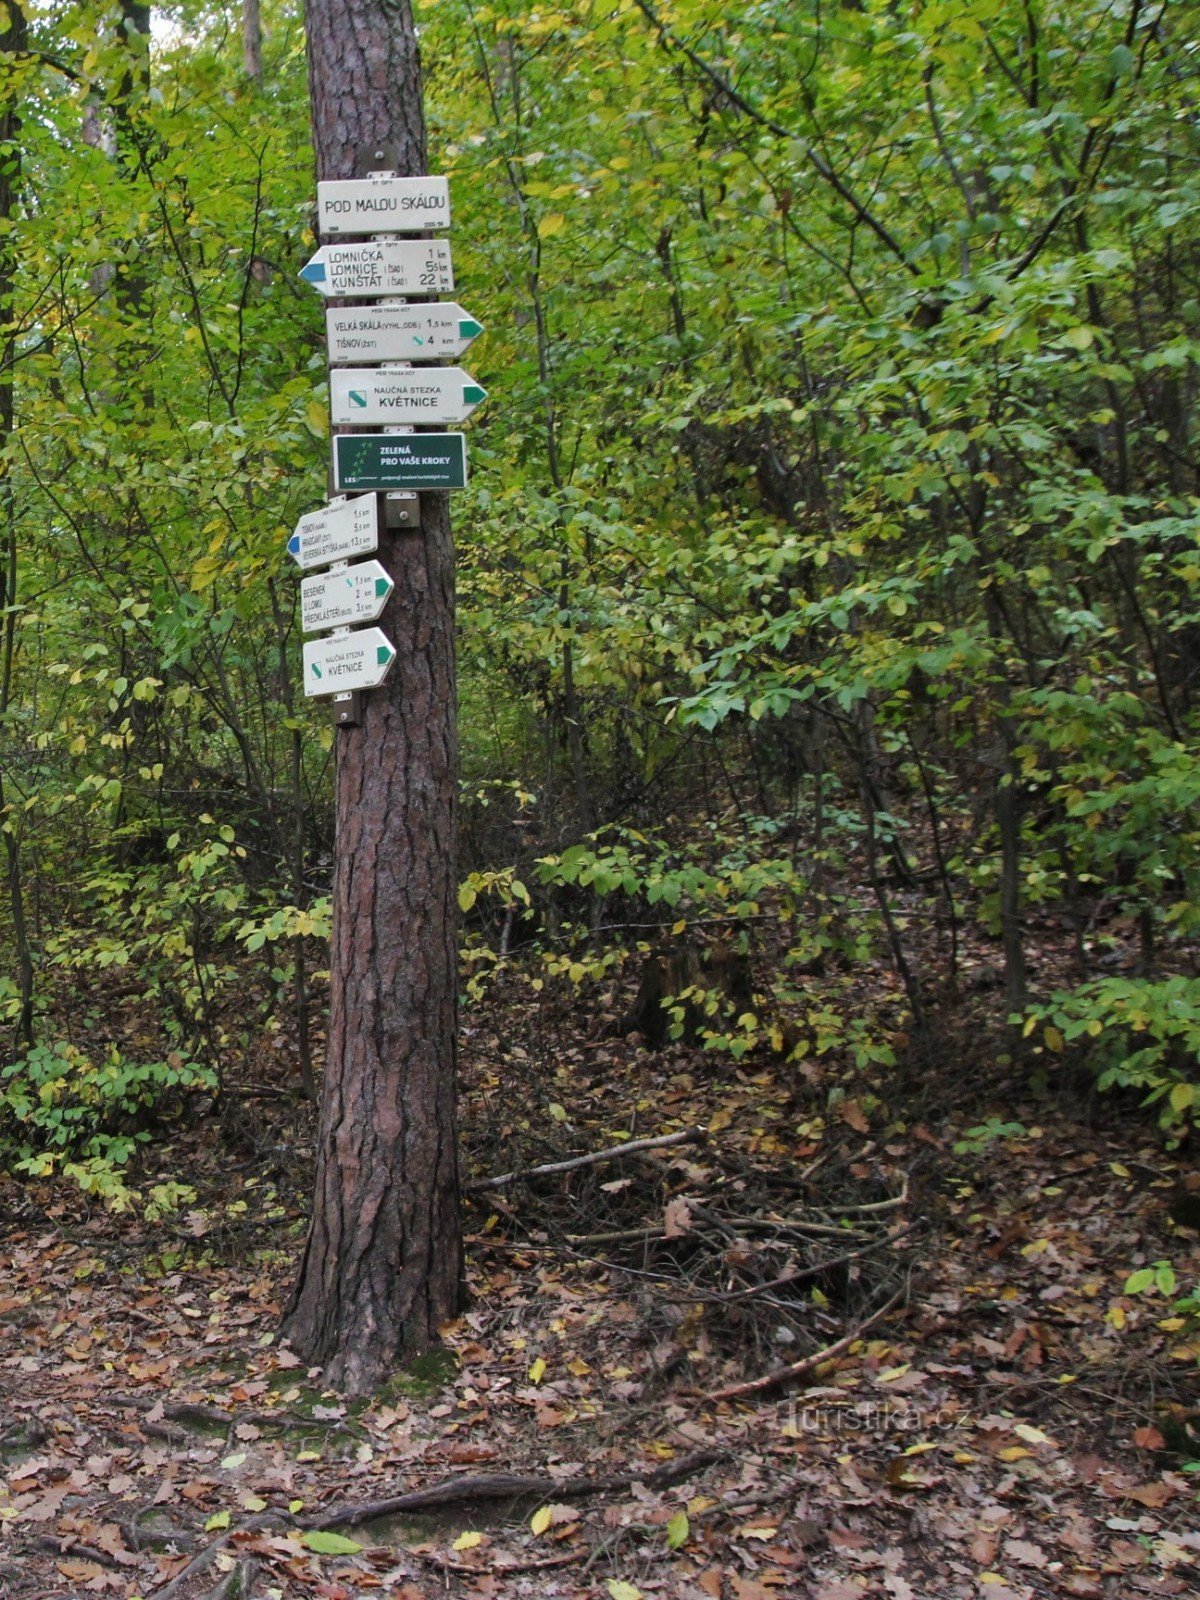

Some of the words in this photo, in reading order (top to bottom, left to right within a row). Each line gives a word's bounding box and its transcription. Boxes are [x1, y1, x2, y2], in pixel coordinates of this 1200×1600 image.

[325, 200, 351, 213] POD
[356, 198, 397, 212] MALOU
[401, 193, 445, 210] SKÁLOU
[329, 249, 384, 263] LOMNIČKA
[428, 249, 433, 258] 1
[437, 249, 446, 258] km
[331, 263, 378, 275] LOMNICE
[438, 263, 448, 271] km
[332, 275, 383, 288] KUNŠTÁT
[419, 274, 436, 285] 22
[440, 276, 449, 284] km
[335, 320, 358, 331] VELKÁ
[360, 319, 381, 331] SKÁLA
[427, 319, 439, 328] 1,5
[336, 337, 361, 348] TIŠNOV
[427, 336, 434, 344] 4
[374, 386, 408, 394] NAUČNÁ
[410, 386, 441, 394] STEZKA
[380, 395, 438, 407] KVĚTNICE
[380, 445, 411, 455] ZELENÁ
[381, 457, 398, 465] PRO
[399, 456, 420, 465] VAŠE
[421, 456, 451, 465] KROKY
[356, 590, 360, 599] 2
[325, 654, 344, 663] NAUČNÁ
[345, 650, 364, 660] STEZKA
[328, 661, 362, 676] KVĚTNICE
